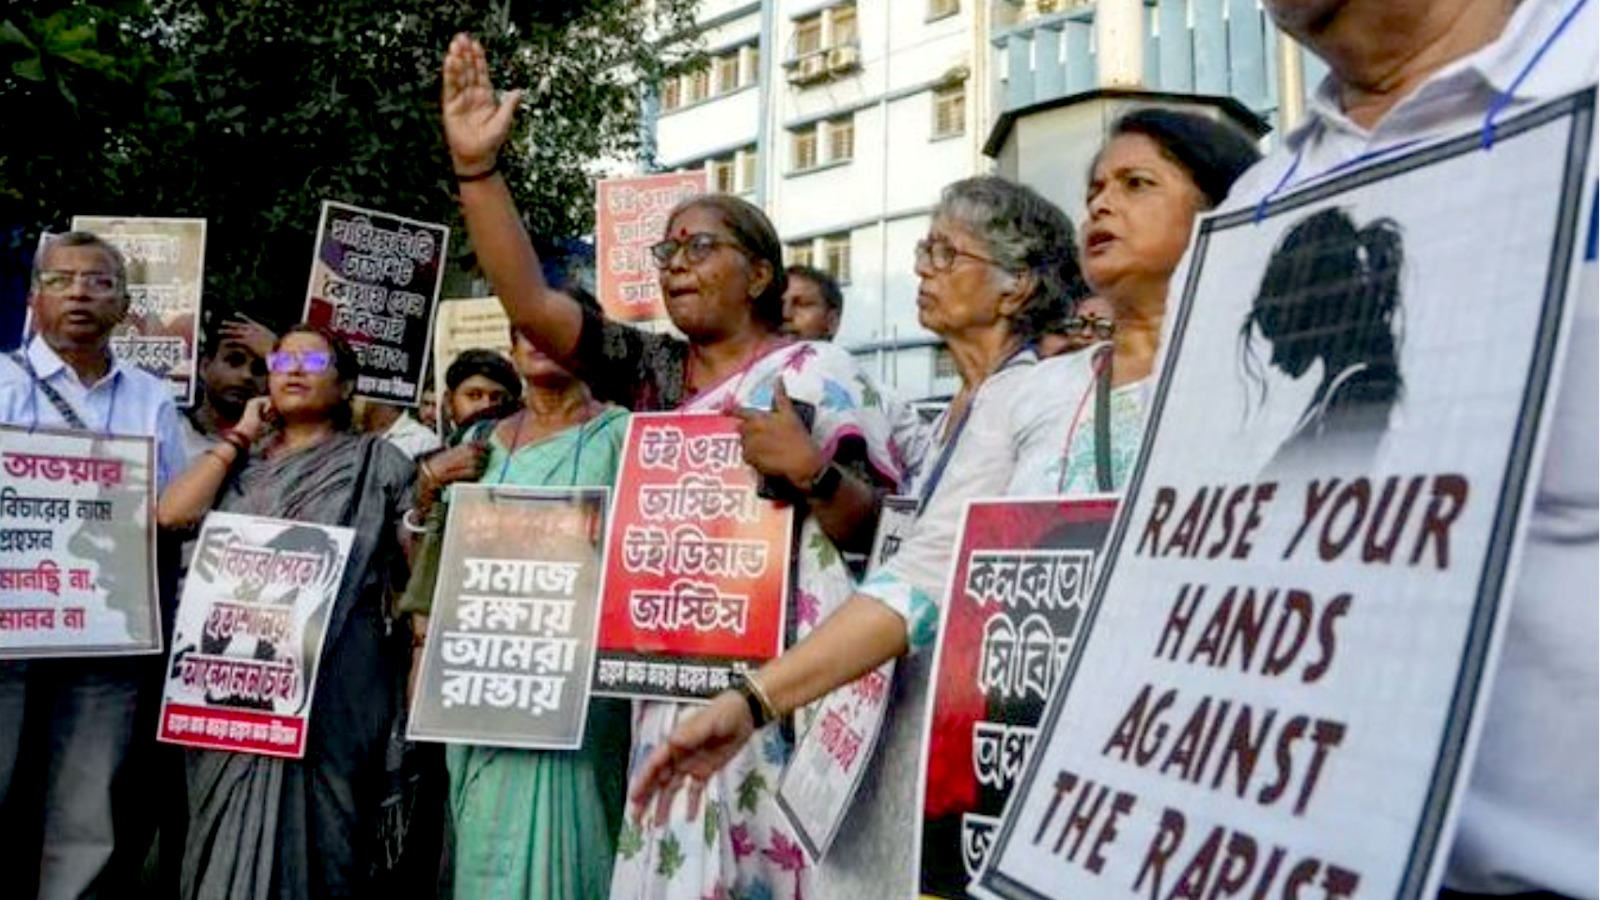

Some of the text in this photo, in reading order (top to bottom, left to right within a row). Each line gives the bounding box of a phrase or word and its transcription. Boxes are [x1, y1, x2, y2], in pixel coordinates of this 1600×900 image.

[3, 452, 124, 486] অভয়ার
[640, 426, 744, 472] উই ওয়া
[0, 486, 113, 524] বিচারের নামে
[1135, 474, 1469, 569] RAISE YOUR
[0, 528, 53, 553] প্রহসন
[623, 523, 769, 578] উই ডিমান্ড
[0, 559, 61, 598] মানছি
[462, 558, 582, 595] সমাজ
[965, 549, 1095, 609] কলকাতা
[0, 607, 86, 632] মানব না
[456, 594, 576, 637] রক্ষায়
[629, 578, 748, 636] জাস্টিস
[441, 632, 577, 675] আমরা
[1154, 584, 1353, 683] HANDS
[440, 669, 566, 716] রাস্তায়
[971, 721, 1038, 789] অপ
[1102, 685, 1347, 817] AGAINST
[1032, 770, 1138, 875] THE
